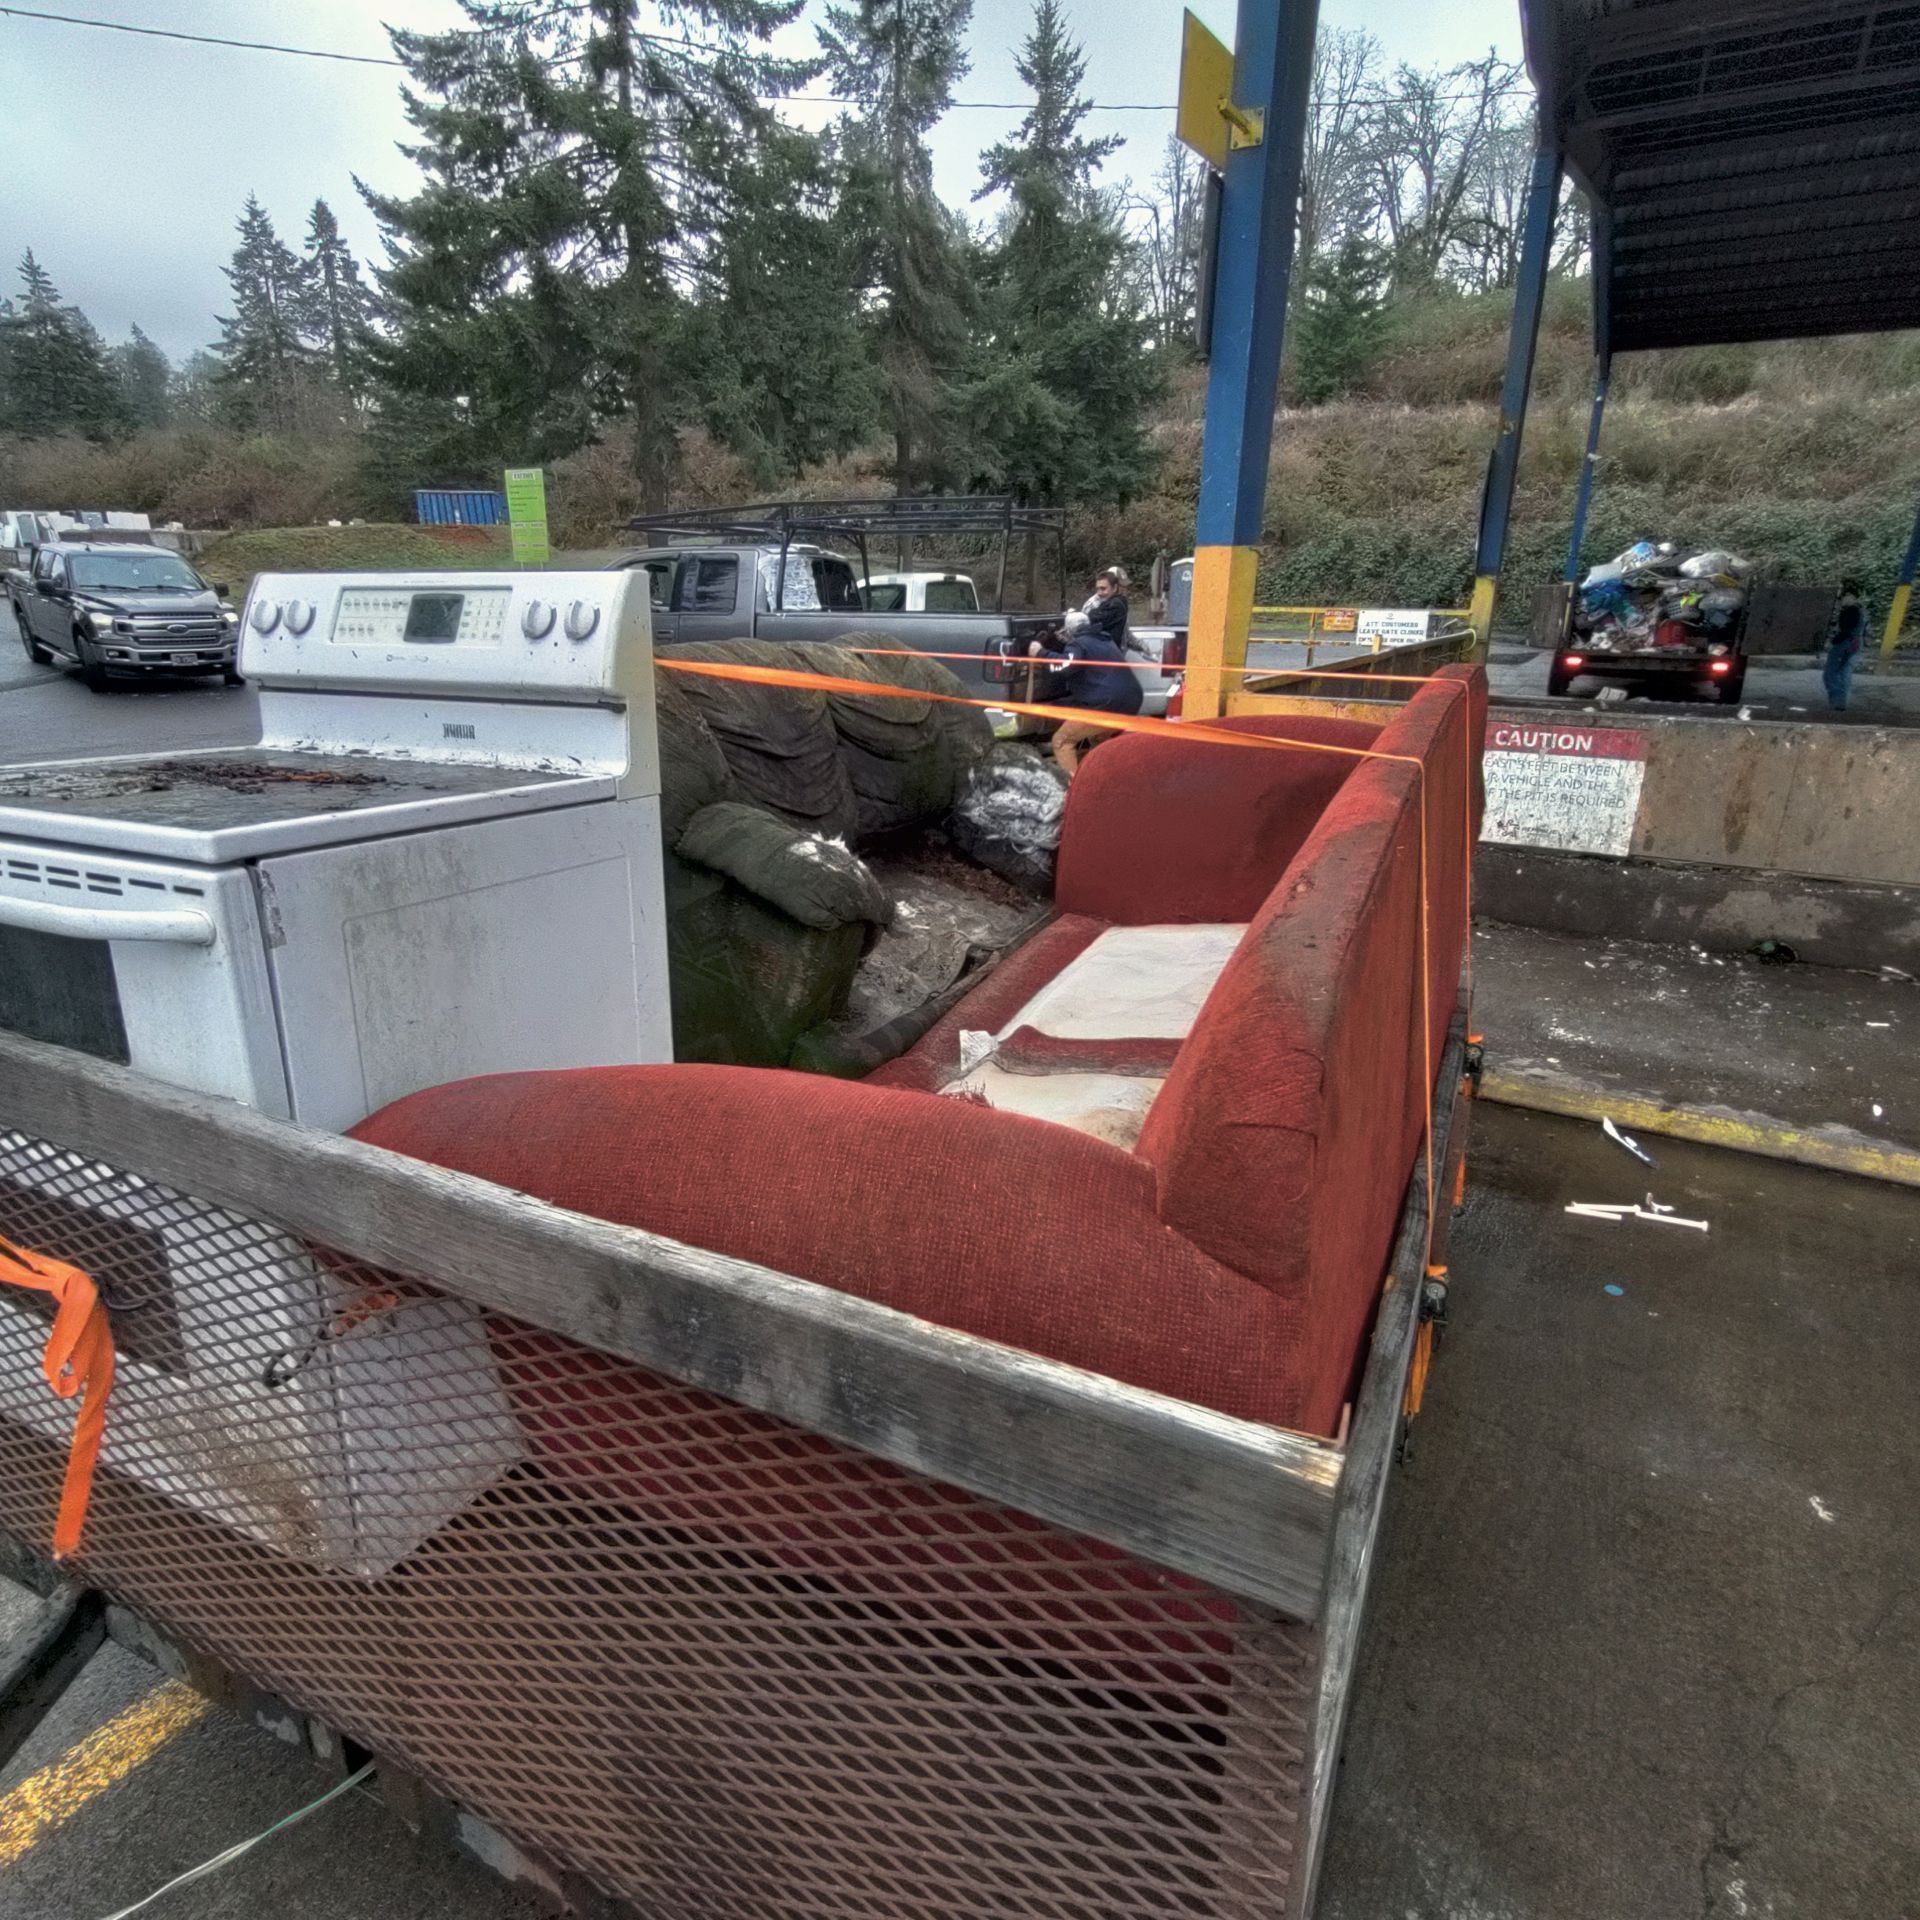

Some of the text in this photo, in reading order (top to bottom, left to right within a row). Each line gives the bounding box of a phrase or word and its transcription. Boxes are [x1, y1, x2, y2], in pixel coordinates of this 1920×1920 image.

[1495, 730, 1593, 751] CAUTION
[1528, 760, 1558, 772] FEET
[1560, 763, 1623, 778] BETWEEN
[1501, 773, 1551, 787] VEHICLE
[1554, 778, 1583, 790] AND
[1586, 779, 1611, 792] THE
[1498, 788, 1521, 800] THE
[1524, 790, 1543, 802] PIT
[1546, 792, 1556, 803] IS
[1560, 794, 1626, 809] REQUIRED
